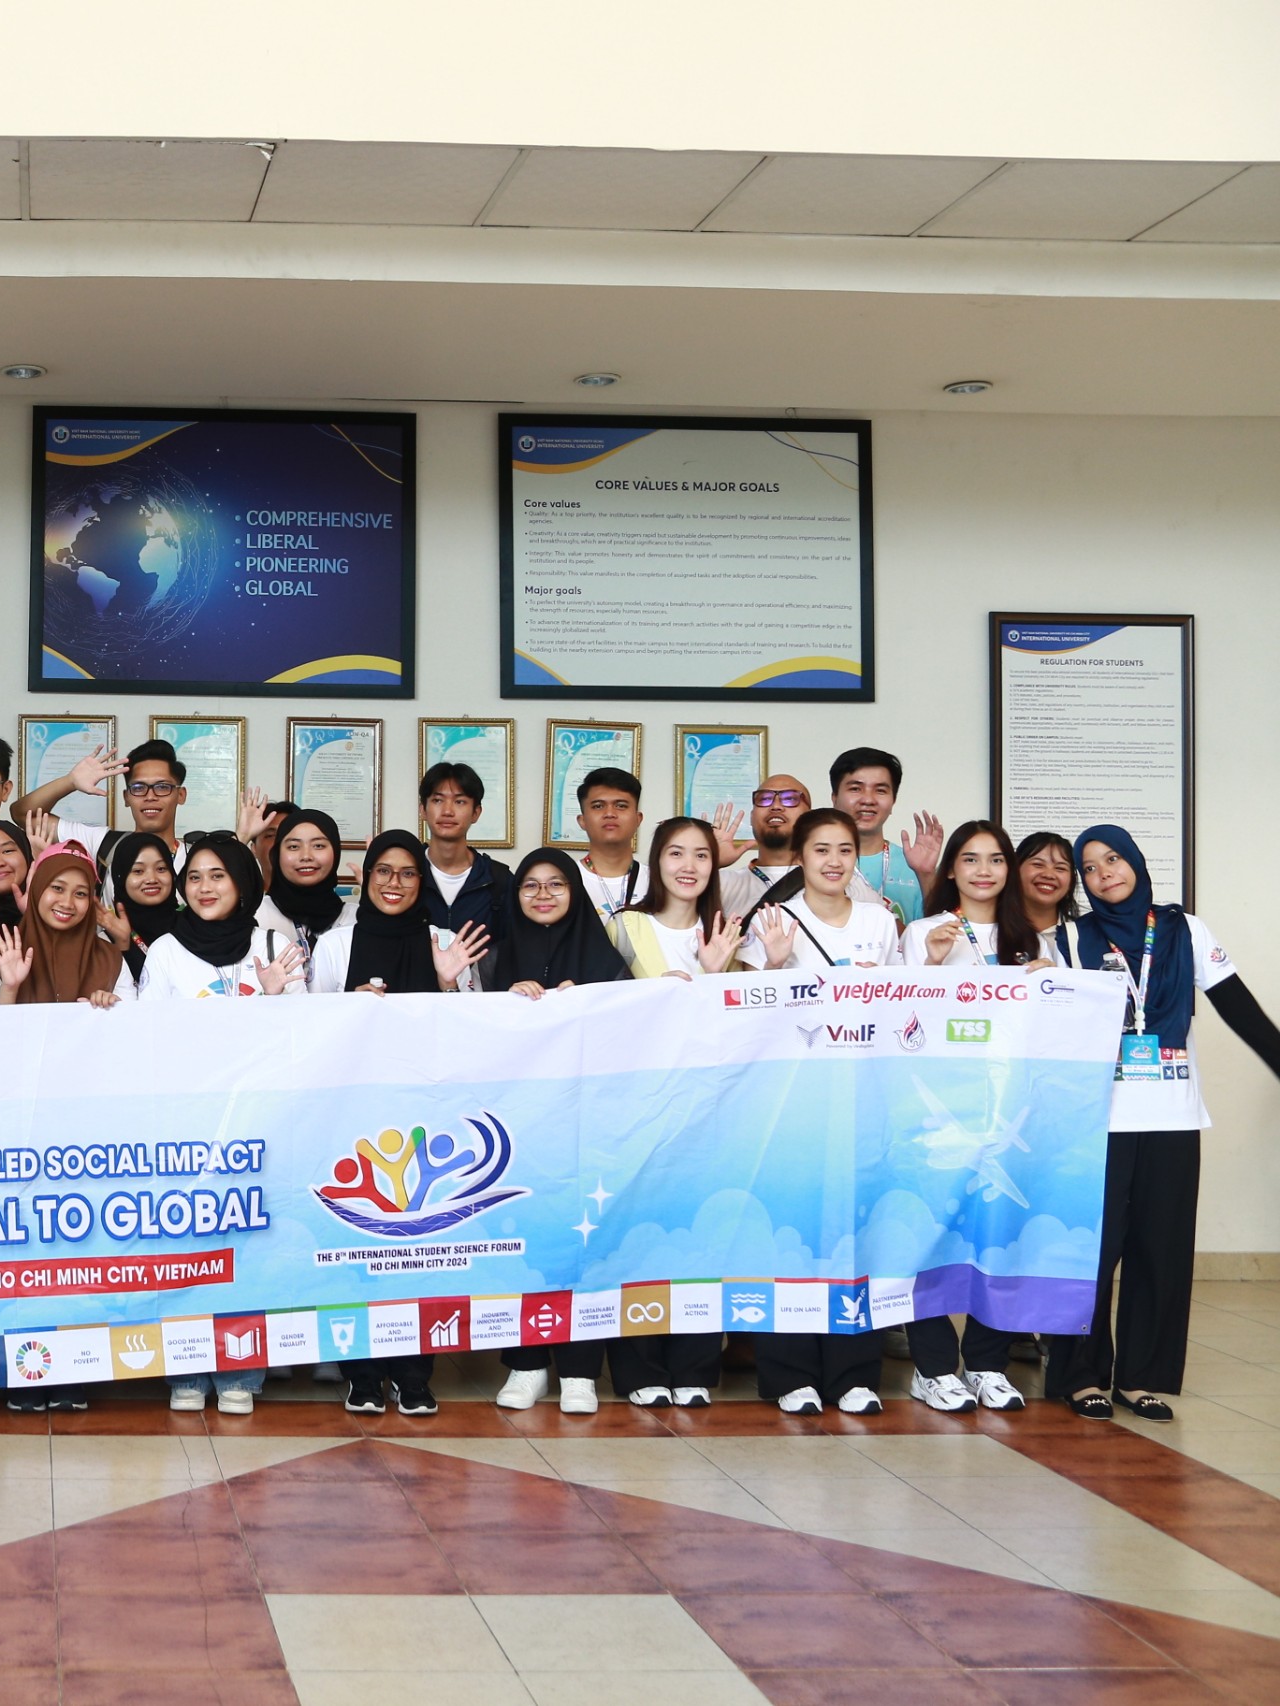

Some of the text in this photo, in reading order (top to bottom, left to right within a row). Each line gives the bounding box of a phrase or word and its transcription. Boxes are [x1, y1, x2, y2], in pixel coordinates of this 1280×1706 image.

[595, 480, 780, 493] CORE VALUES & MAJOR GOALS
[524, 499, 581, 509] Core values
[246, 510, 393, 529] COMPREHENSIVE
[246, 534, 319, 551] LIBERAL
[246, 557, 349, 575] PIONEERING
[245, 580, 318, 597] GLOBAL
[525, 586, 582, 597] Major goals
[1040, 658, 1087, 666] REGULATION
[1106, 659, 1144, 667] STUDENTS
[744, 987, 777, 1006] ISB
[982, 984, 1028, 1001] SCG
[784, 999, 824, 1008] HOSPITALITY
[950, 1021, 986, 1037] YSS
[44, 1143, 153, 1181] SOCIAL
[157, 1139, 265, 1177] IMPACT
[33, 1193, 93, 1243] TO
[102, 1186, 270, 1240] GLOBAL
[317, 1253, 333, 1262] THE
[348, 1248, 413, 1261] INTERNATIONAL
[414, 1246, 451, 1257] STUDENT
[454, 1243, 489, 1254] SCIENCE
[491, 1242, 522, 1253] FORUM
[370, 1257, 468, 1271] HO CHI MINH CITY 2024
[20, 1268, 53, 1287] CHI
[56, 1266, 102, 1286] MINH
[107, 1263, 149, 1286] CITY,
[153, 1259, 224, 1282] VIETNAM
[872, 1293, 909, 1304] PARTNERSHIPS
[892, 1300, 911, 1308] GOALS
[579, 1306, 615, 1314] SUSTAINABLE
[375, 1321, 413, 1329] AFFORDABLE
[471, 1331, 519, 1339] INFRASTRUCTURE
[279, 1340, 307, 1348] EQUALITY
[73, 1357, 100, 1365] POVERTY
